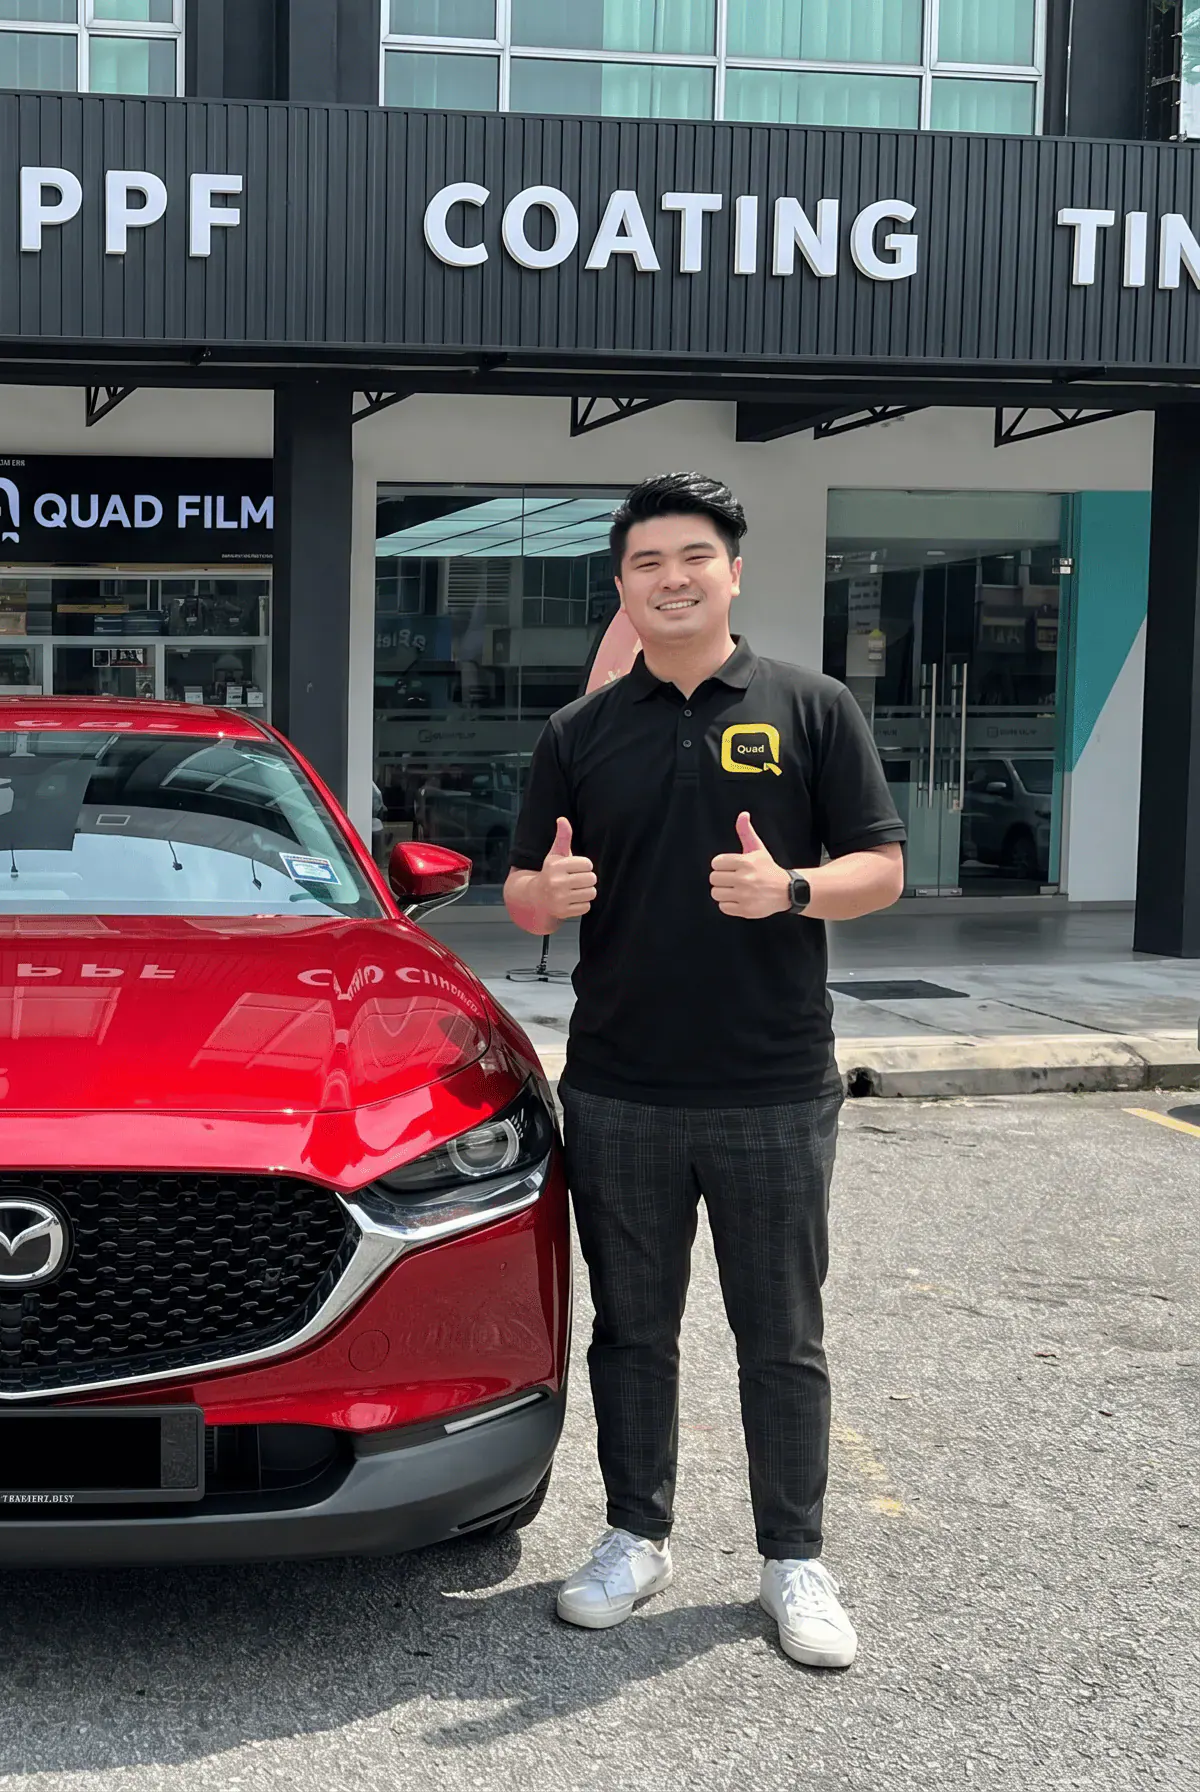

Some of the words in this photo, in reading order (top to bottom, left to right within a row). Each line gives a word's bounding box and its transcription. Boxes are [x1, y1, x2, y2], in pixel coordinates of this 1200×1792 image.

[19, 166, 243, 258] PPF
[423, 181, 919, 281] COATING
[33, 493, 163, 528] QUAD
[177, 495, 274, 529] FILM
[737, 744, 765, 755] Quad
